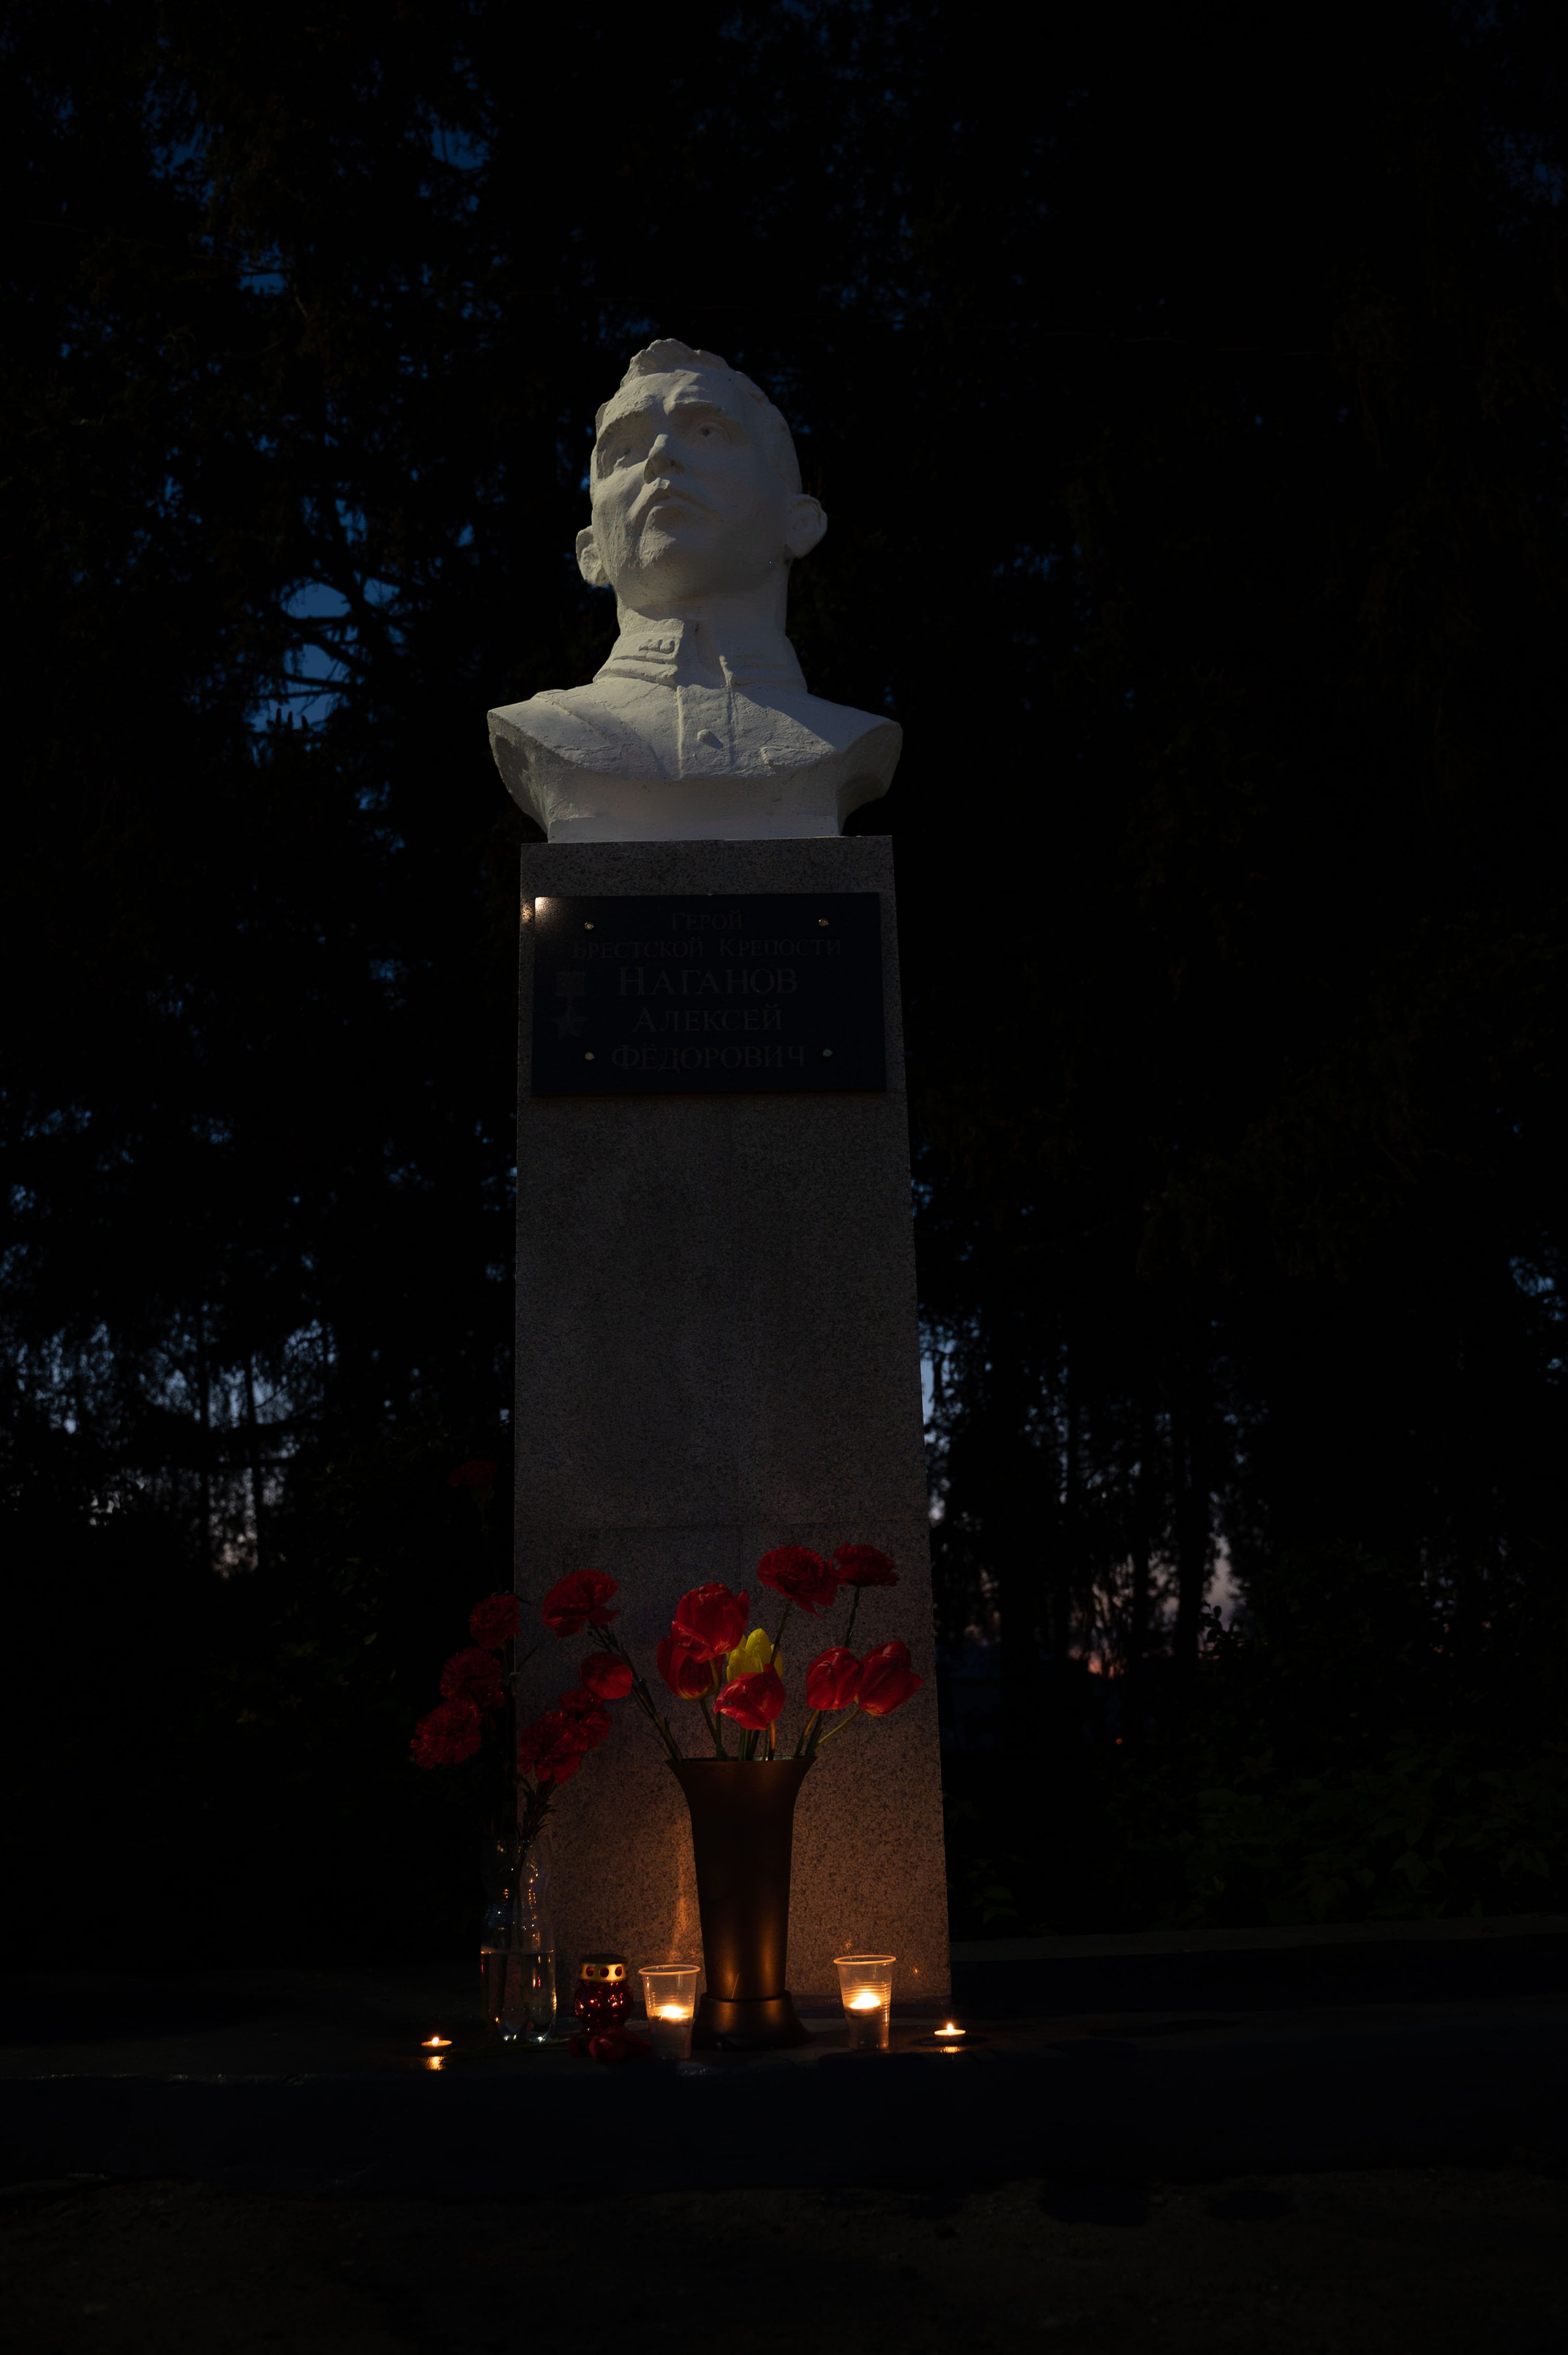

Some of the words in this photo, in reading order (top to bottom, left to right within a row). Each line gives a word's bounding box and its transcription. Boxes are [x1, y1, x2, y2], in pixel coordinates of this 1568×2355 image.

[671, 910, 743, 930] ГЕРОЙ
[573, 937, 704, 959] БРЕСТСКОЙ
[719, 938, 841, 956] КРЕПОСТИ
[619, 966, 798, 996] НАГАНОВ
[632, 1002, 782, 1032] АЛЕКСЕЙ
[611, 1043, 807, 1073] ФЁДОРОВИЧ
